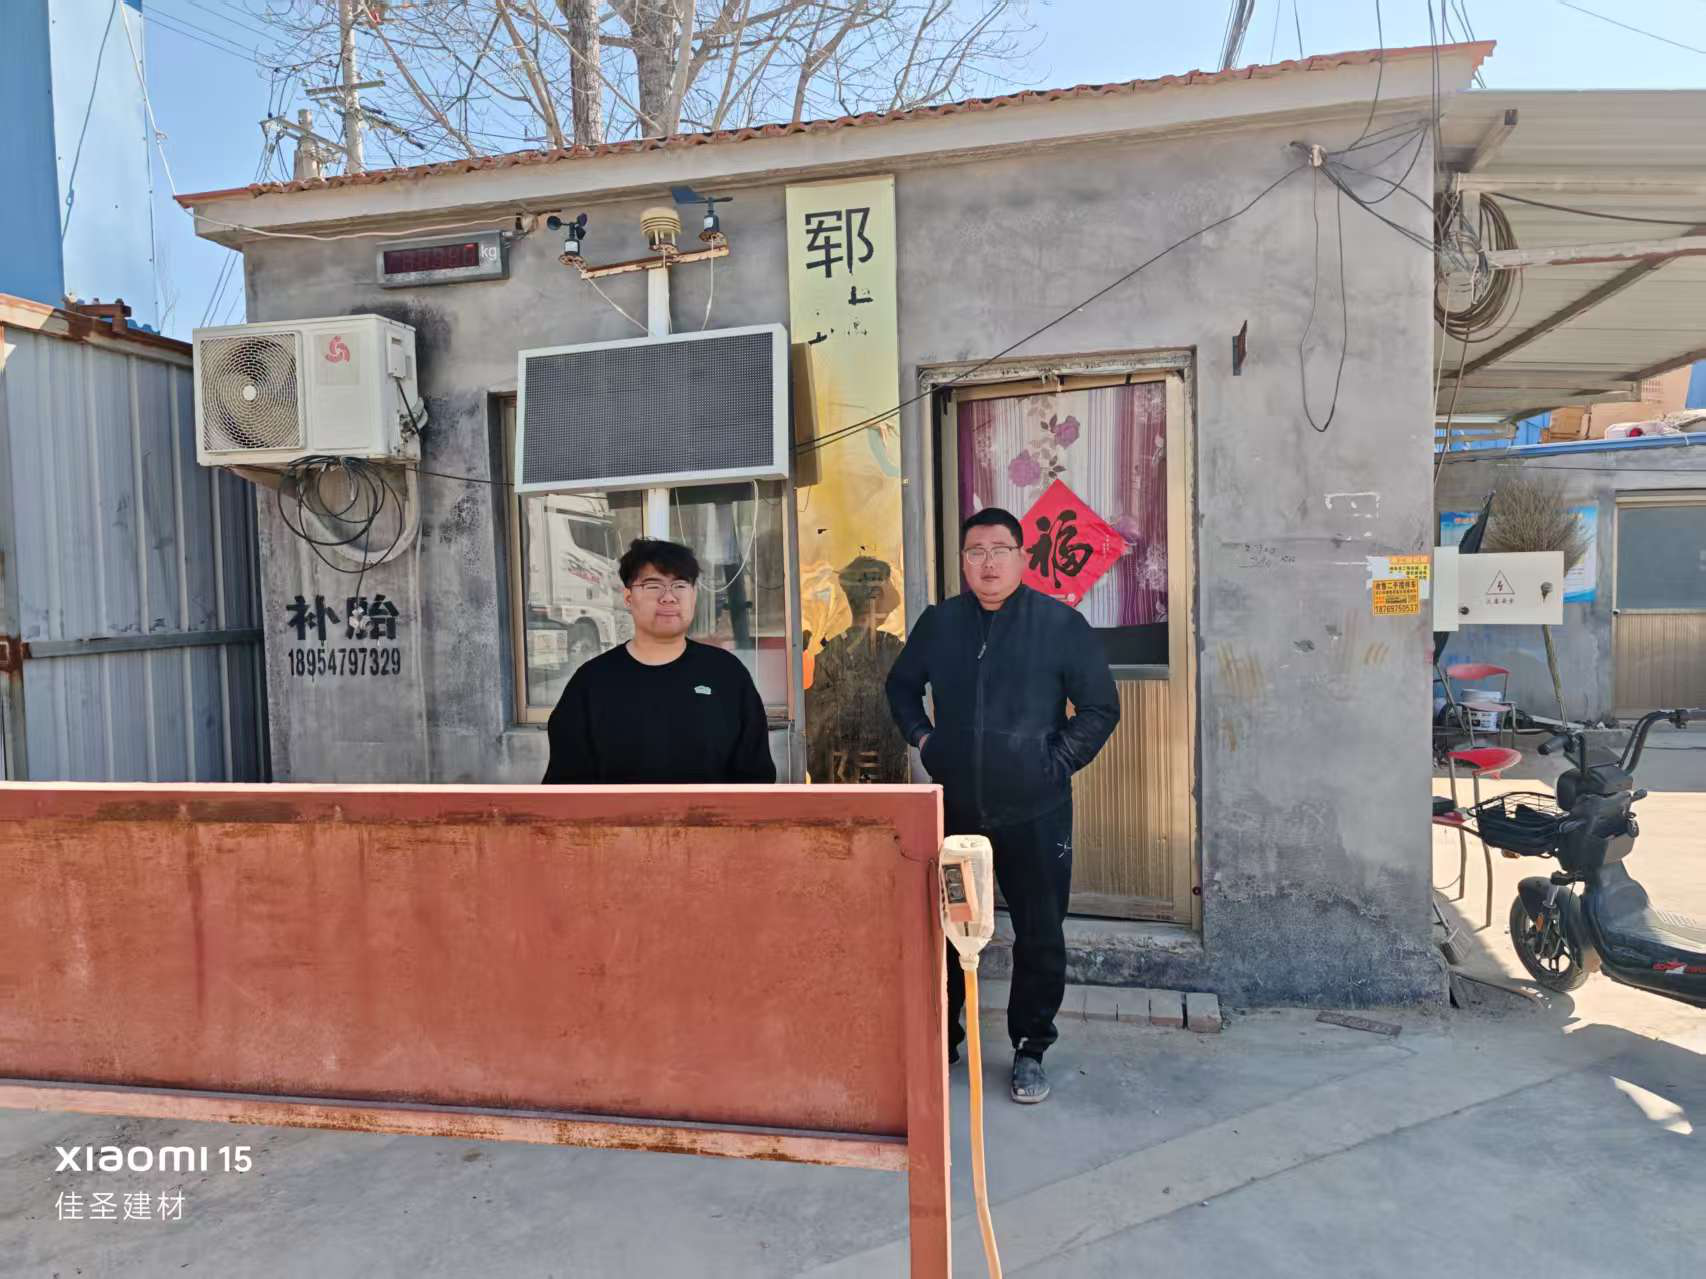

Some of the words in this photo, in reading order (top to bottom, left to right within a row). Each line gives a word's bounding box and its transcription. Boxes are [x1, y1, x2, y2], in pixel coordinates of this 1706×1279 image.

[480, 243, 497, 261] kg
[804, 207, 875, 279] 郓
[1026, 509, 1094, 590] 福
[285, 594, 400, 640] 补胎
[288, 647, 401, 677] 18954797329
